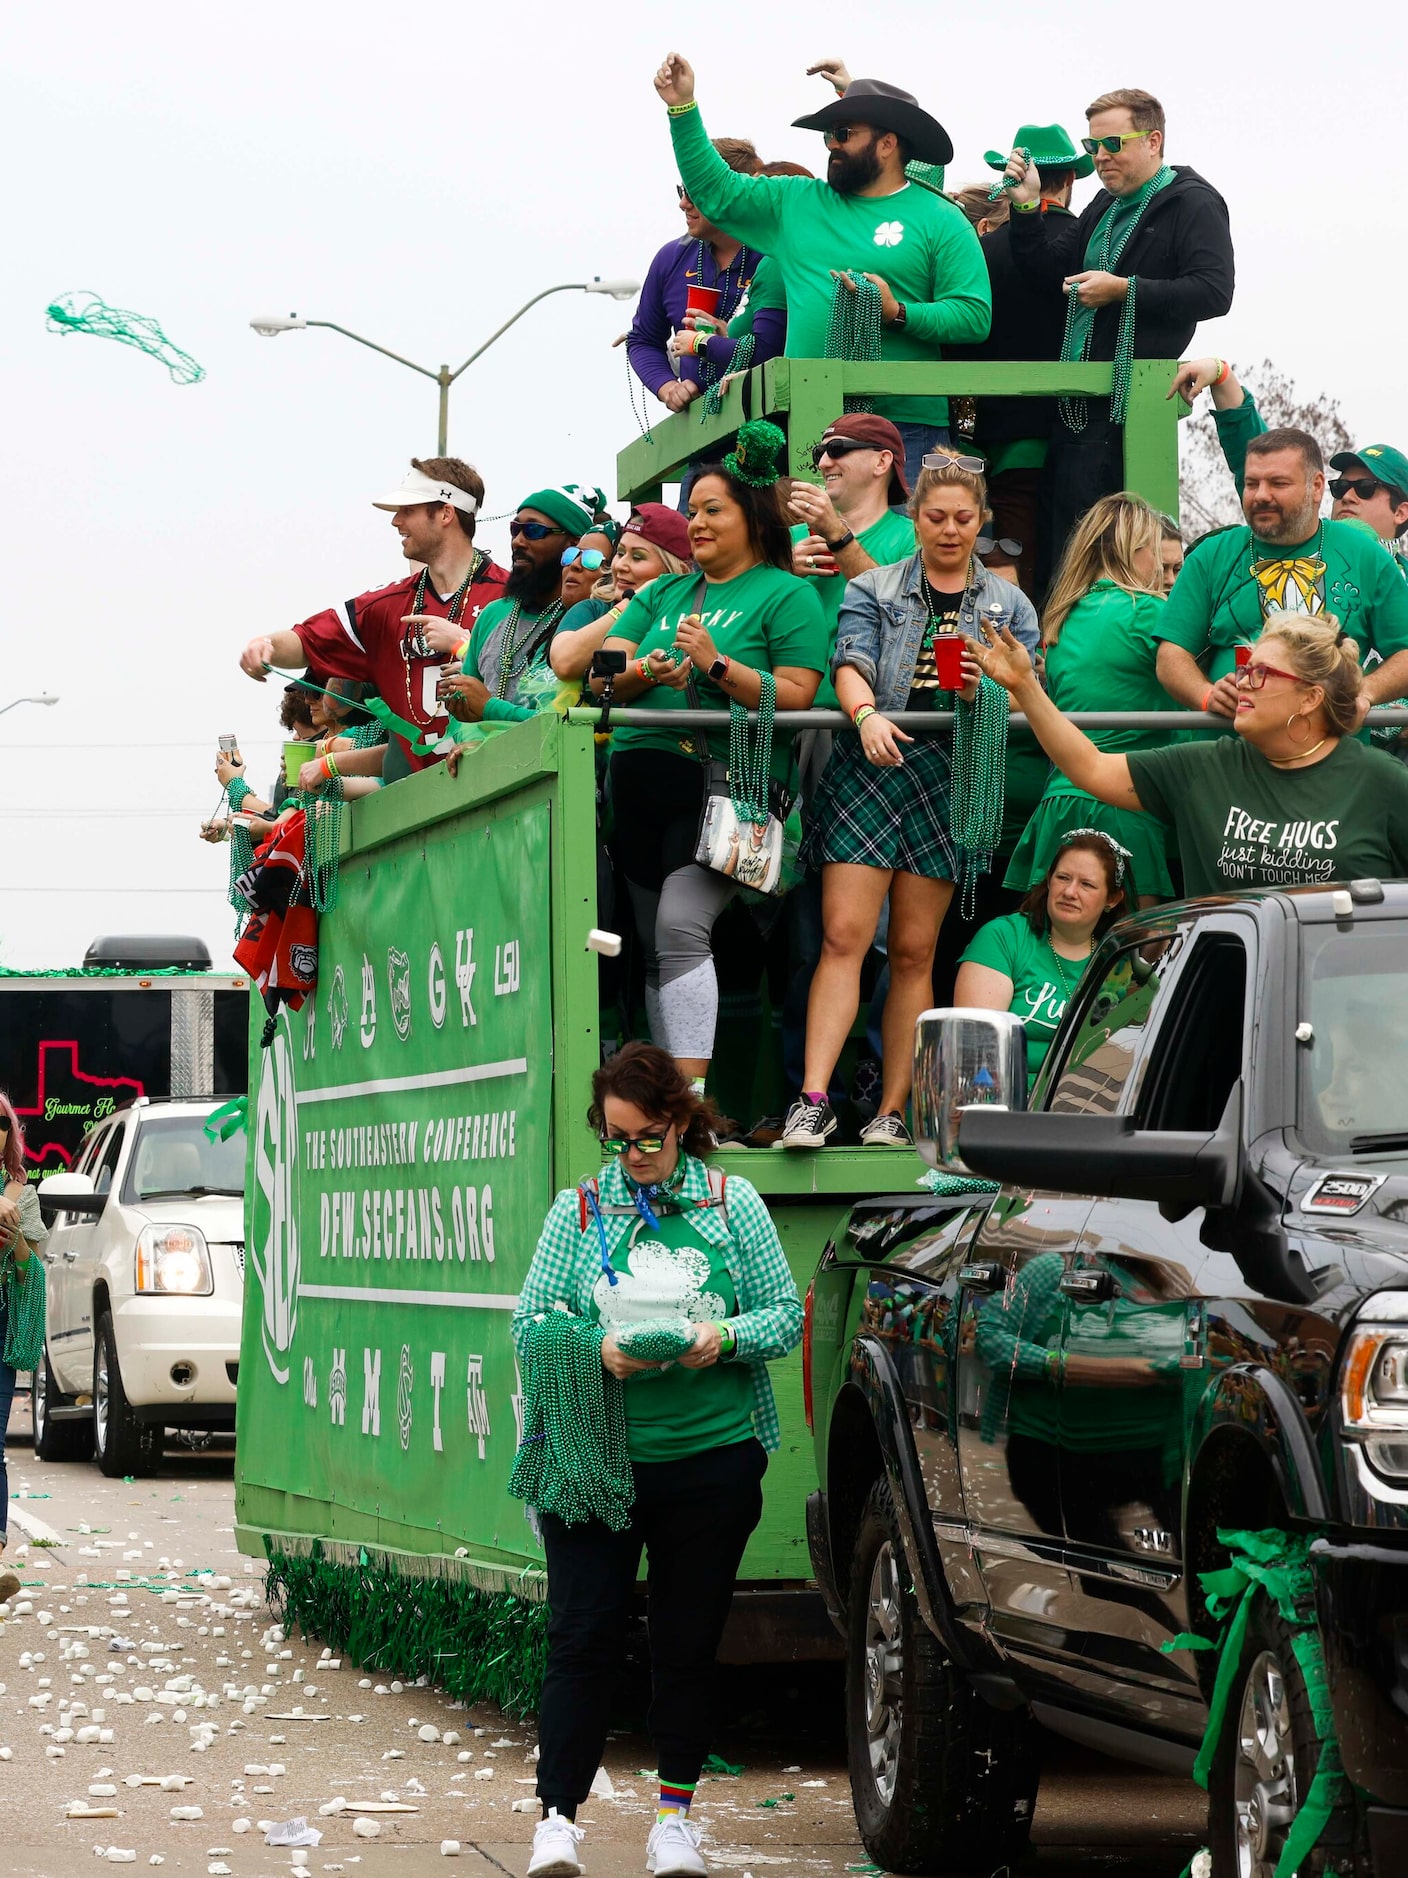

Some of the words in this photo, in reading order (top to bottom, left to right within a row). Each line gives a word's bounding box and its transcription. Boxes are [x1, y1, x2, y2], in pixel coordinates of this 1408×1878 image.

[1223, 805, 1278, 844] FREE
[1277, 820, 1340, 850] HUGS
[1216, 841, 1257, 868] just
[1260, 844, 1336, 881] kidding
[1222, 861, 1257, 880] DON'T
[1259, 868, 1300, 884] TOUCH
[494, 939, 520, 996] LSU
[45, 1097, 91, 1121] Gourmet
[306, 1131, 327, 1170] THE
[330, 1121, 419, 1169] SOUTHEASTERN
[423, 1110, 516, 1163] CONFERENCE
[1321, 1181, 1369, 1197] 2500
[320, 1184, 495, 1262] DFW.SECFANS.ORG
